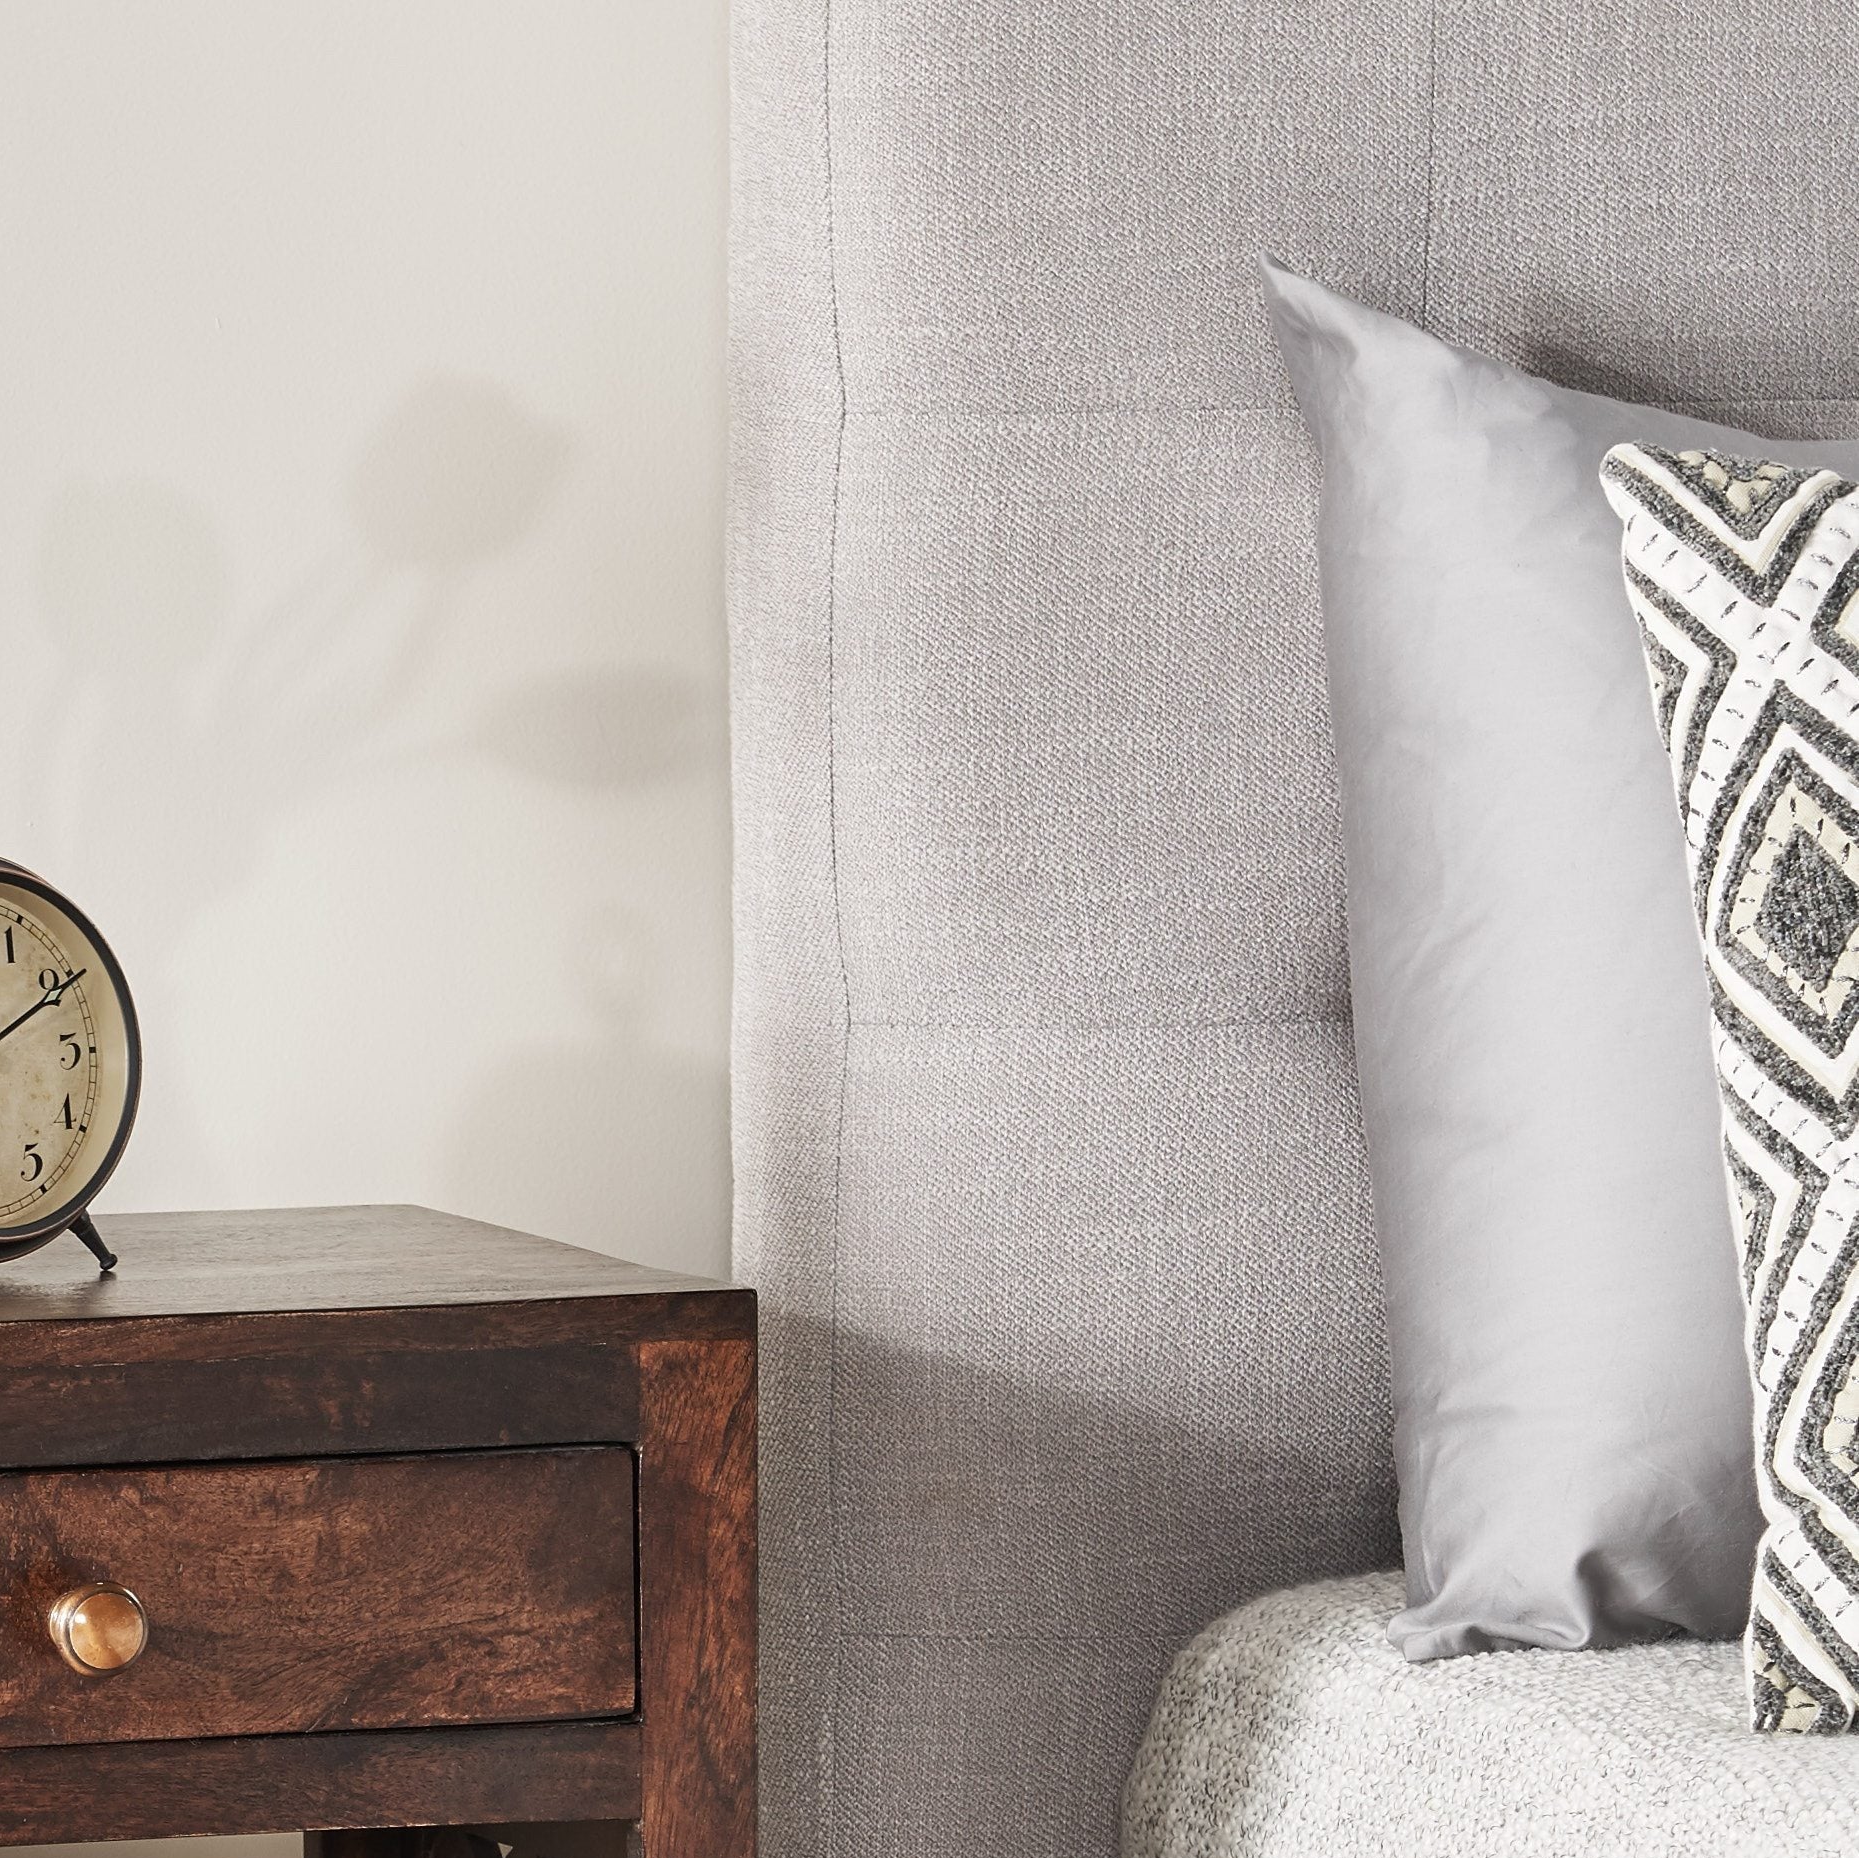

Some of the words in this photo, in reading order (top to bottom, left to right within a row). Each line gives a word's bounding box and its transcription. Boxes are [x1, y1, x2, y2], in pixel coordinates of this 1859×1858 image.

[4, 926, 17, 963] 1
[59, 1033, 82, 1071] 3
[53, 1093, 77, 1130] 4
[21, 1143, 43, 1182] 5
